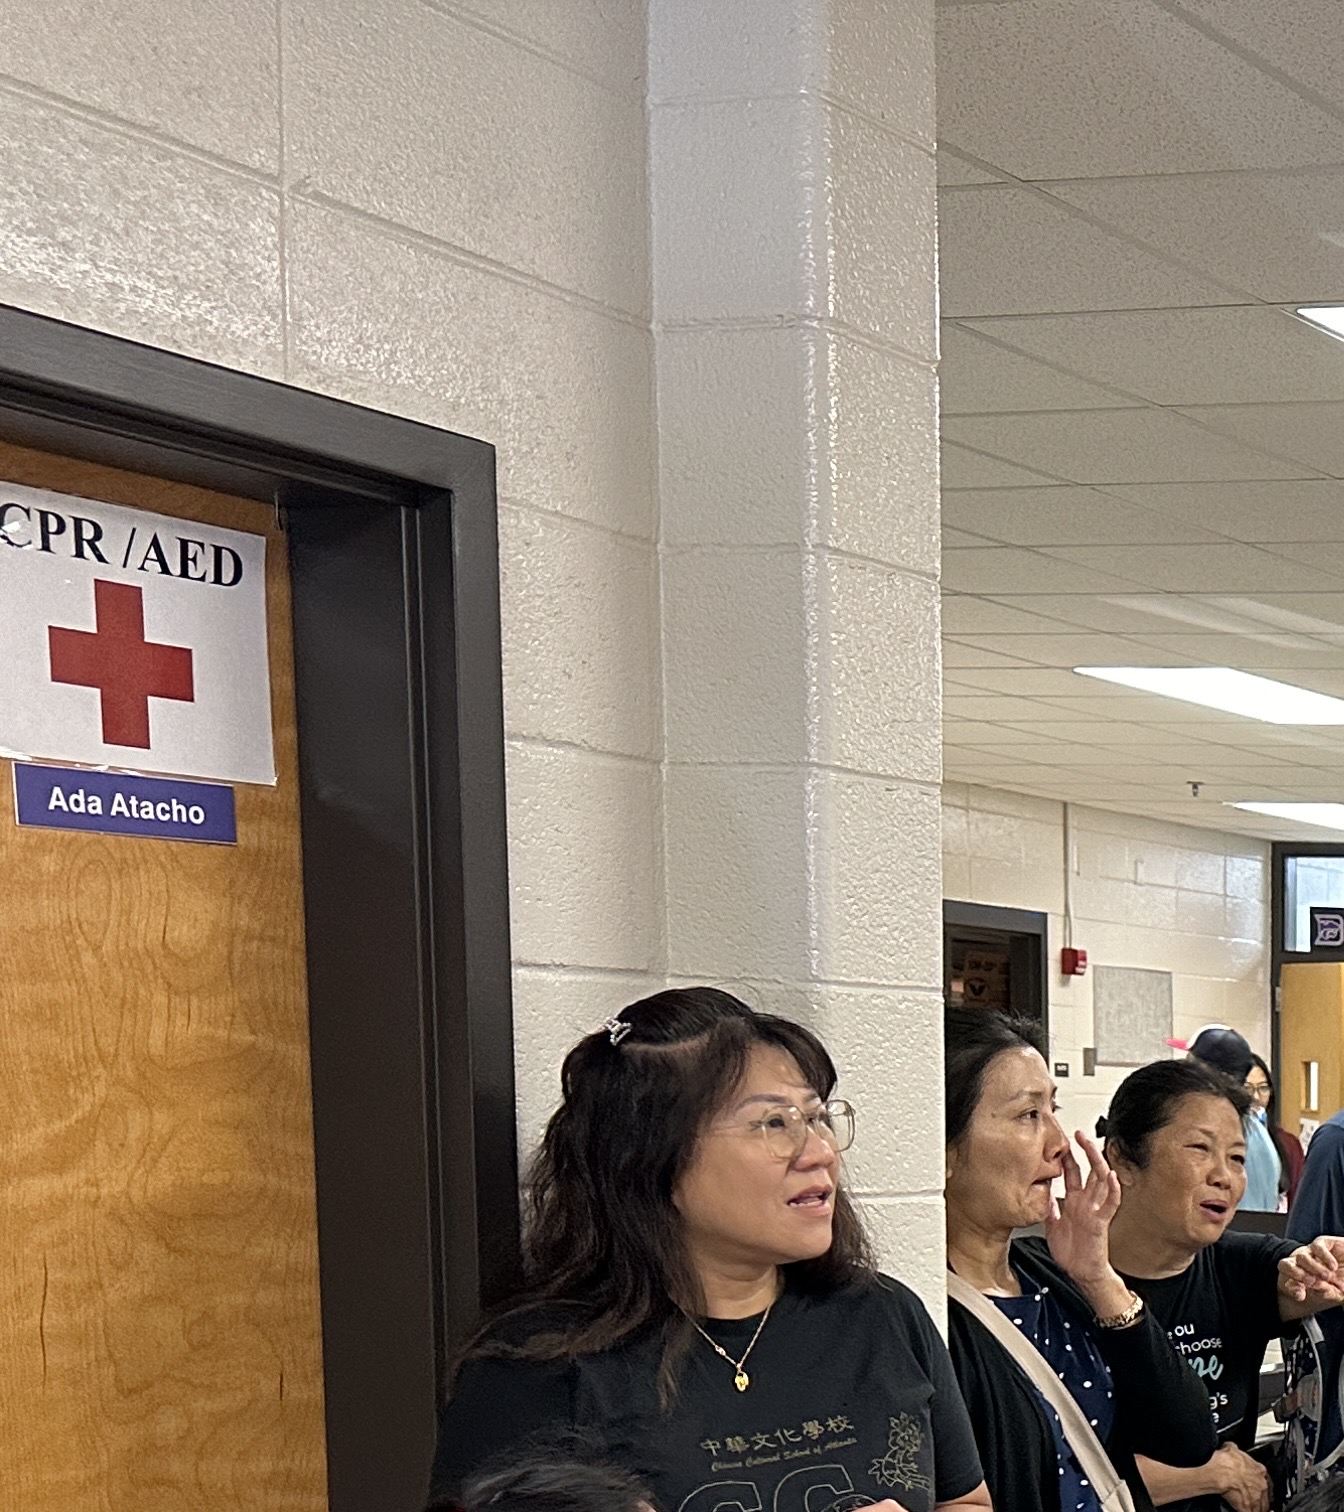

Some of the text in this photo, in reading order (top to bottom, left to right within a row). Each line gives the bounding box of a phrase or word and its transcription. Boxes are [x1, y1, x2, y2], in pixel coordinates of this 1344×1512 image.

[0, 503, 243, 587] CPR /AED
[48, 786, 206, 825] Ada Atacho
